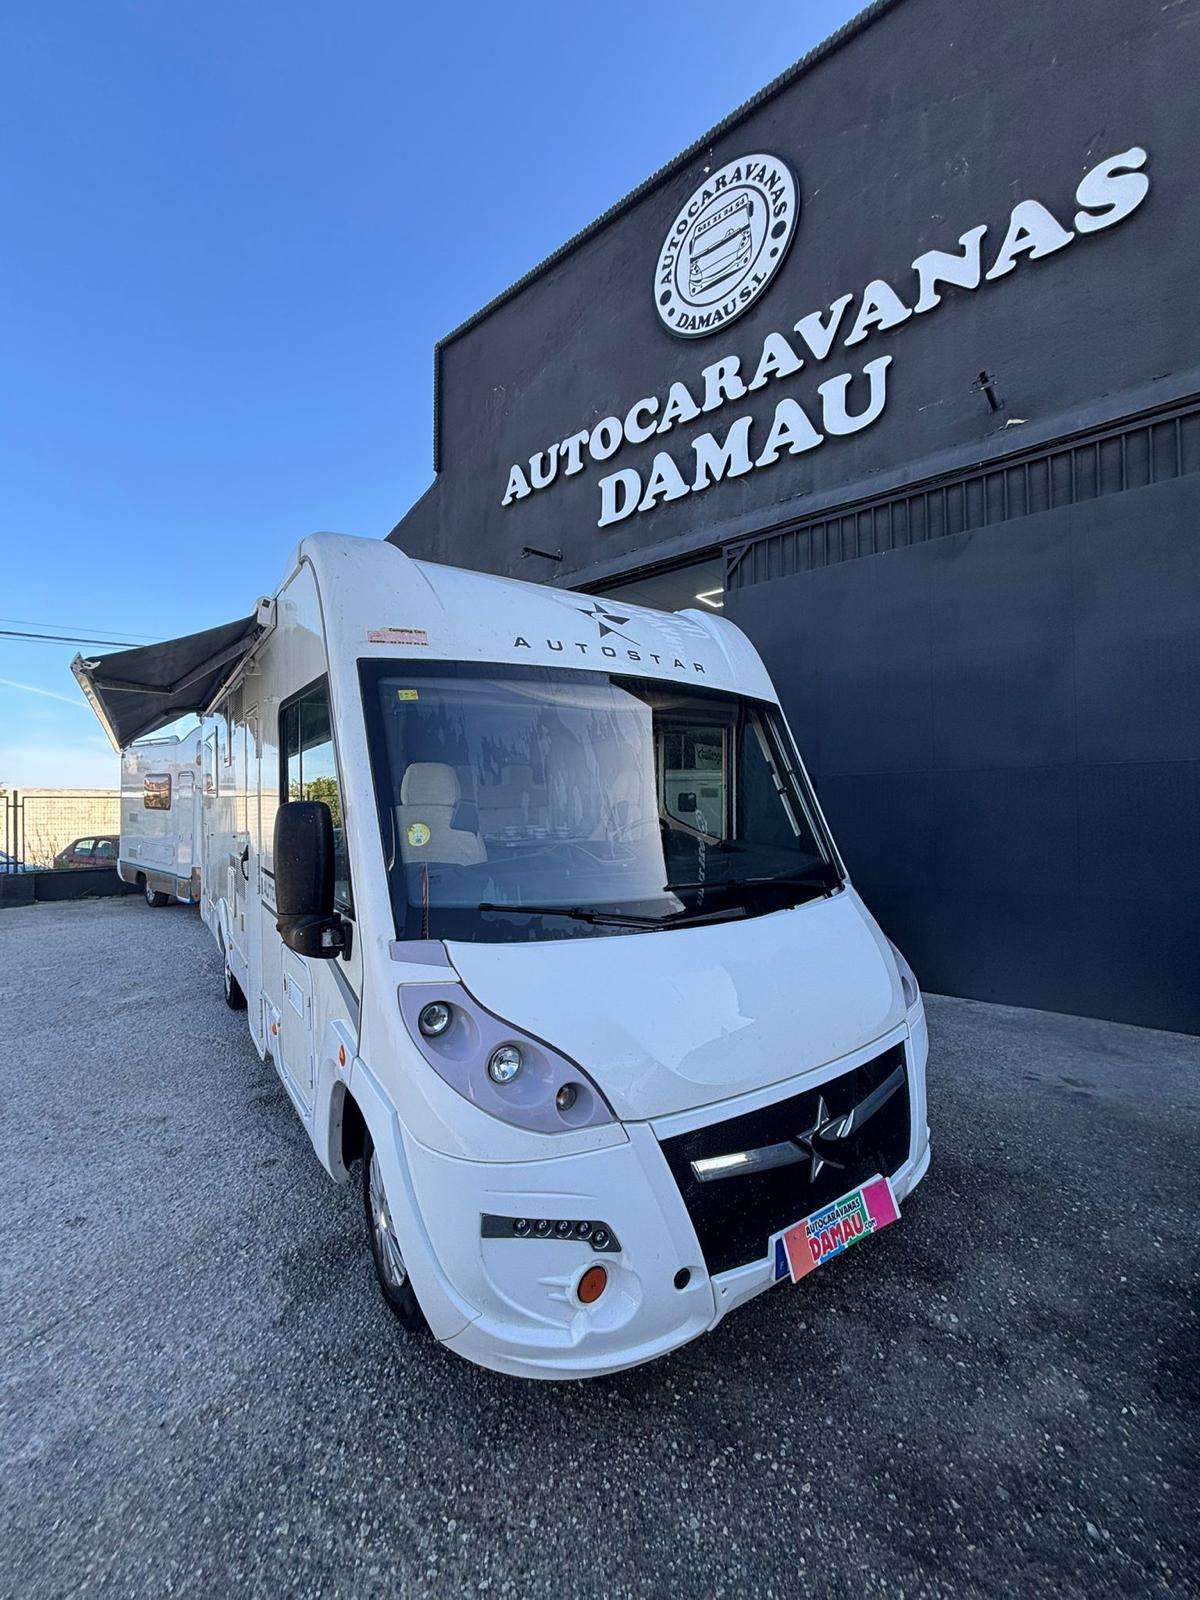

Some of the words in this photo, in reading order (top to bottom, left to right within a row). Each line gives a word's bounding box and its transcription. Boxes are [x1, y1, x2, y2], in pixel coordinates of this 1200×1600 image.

[661, 162, 788, 285] AUTOCARAVANAS
[501, 147, 1150, 506] AUTOCARAVANAS
[675, 298, 737, 330] DAMAU
[597, 355, 893, 528] DAMAU
[514, 636, 706, 674] AUTOSTAR
[805, 1197, 861, 1236] AUTOCARAVANAS
[808, 1212, 864, 1261] DAMAU
